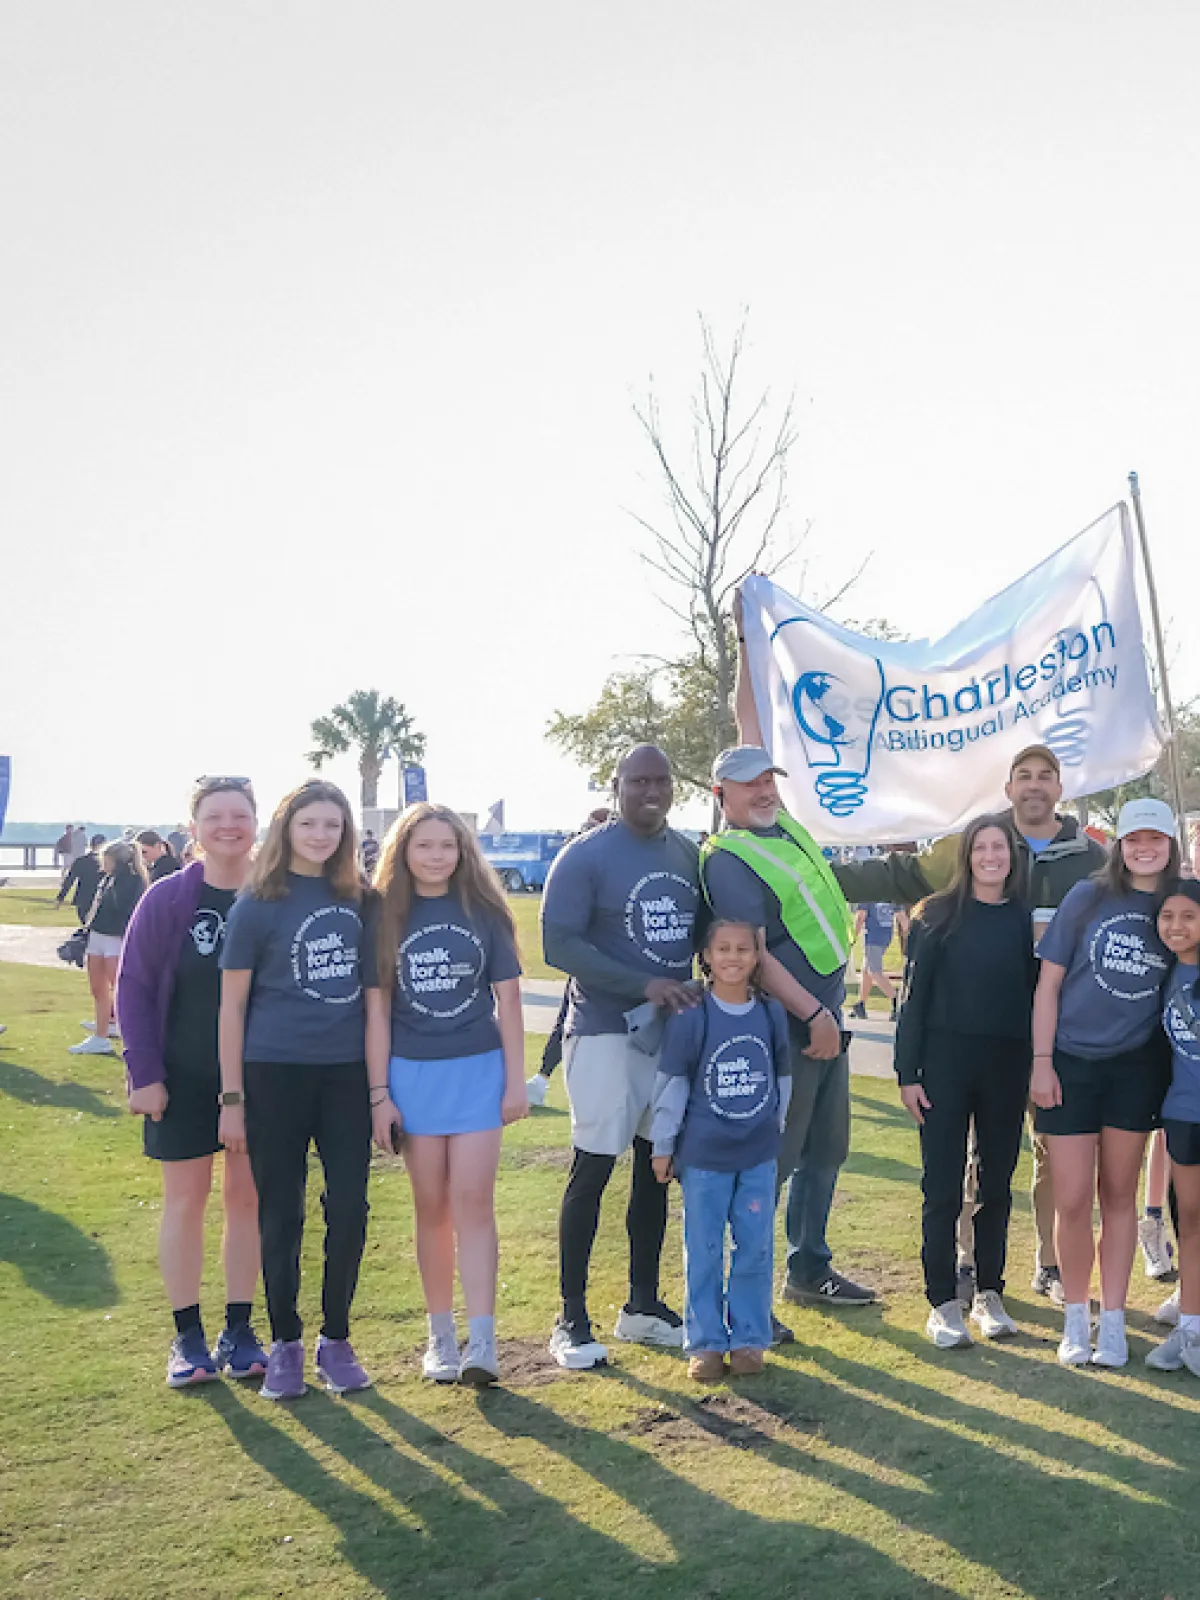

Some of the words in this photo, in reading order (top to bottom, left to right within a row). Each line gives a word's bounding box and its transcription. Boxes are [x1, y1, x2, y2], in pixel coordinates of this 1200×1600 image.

[885, 621, 1116, 721] Charleston
[886, 709, 1004, 752] Bilingual
[1014, 664, 1117, 723] Academy
[640, 896, 678, 911] walk
[642, 910, 667, 927] for
[305, 932, 344, 949] walk
[645, 928, 688, 941] water
[1107, 931, 1144, 949] walk
[307, 947, 330, 967] for
[408, 948, 450, 963] walk
[1105, 941, 1129, 959] for
[307, 964, 353, 981] water
[409, 961, 436, 979] for
[1102, 957, 1150, 975] water
[412, 977, 460, 993] water
[717, 1057, 750, 1072] walk
[717, 1070, 737, 1086] for
[717, 1084, 757, 1097] water
